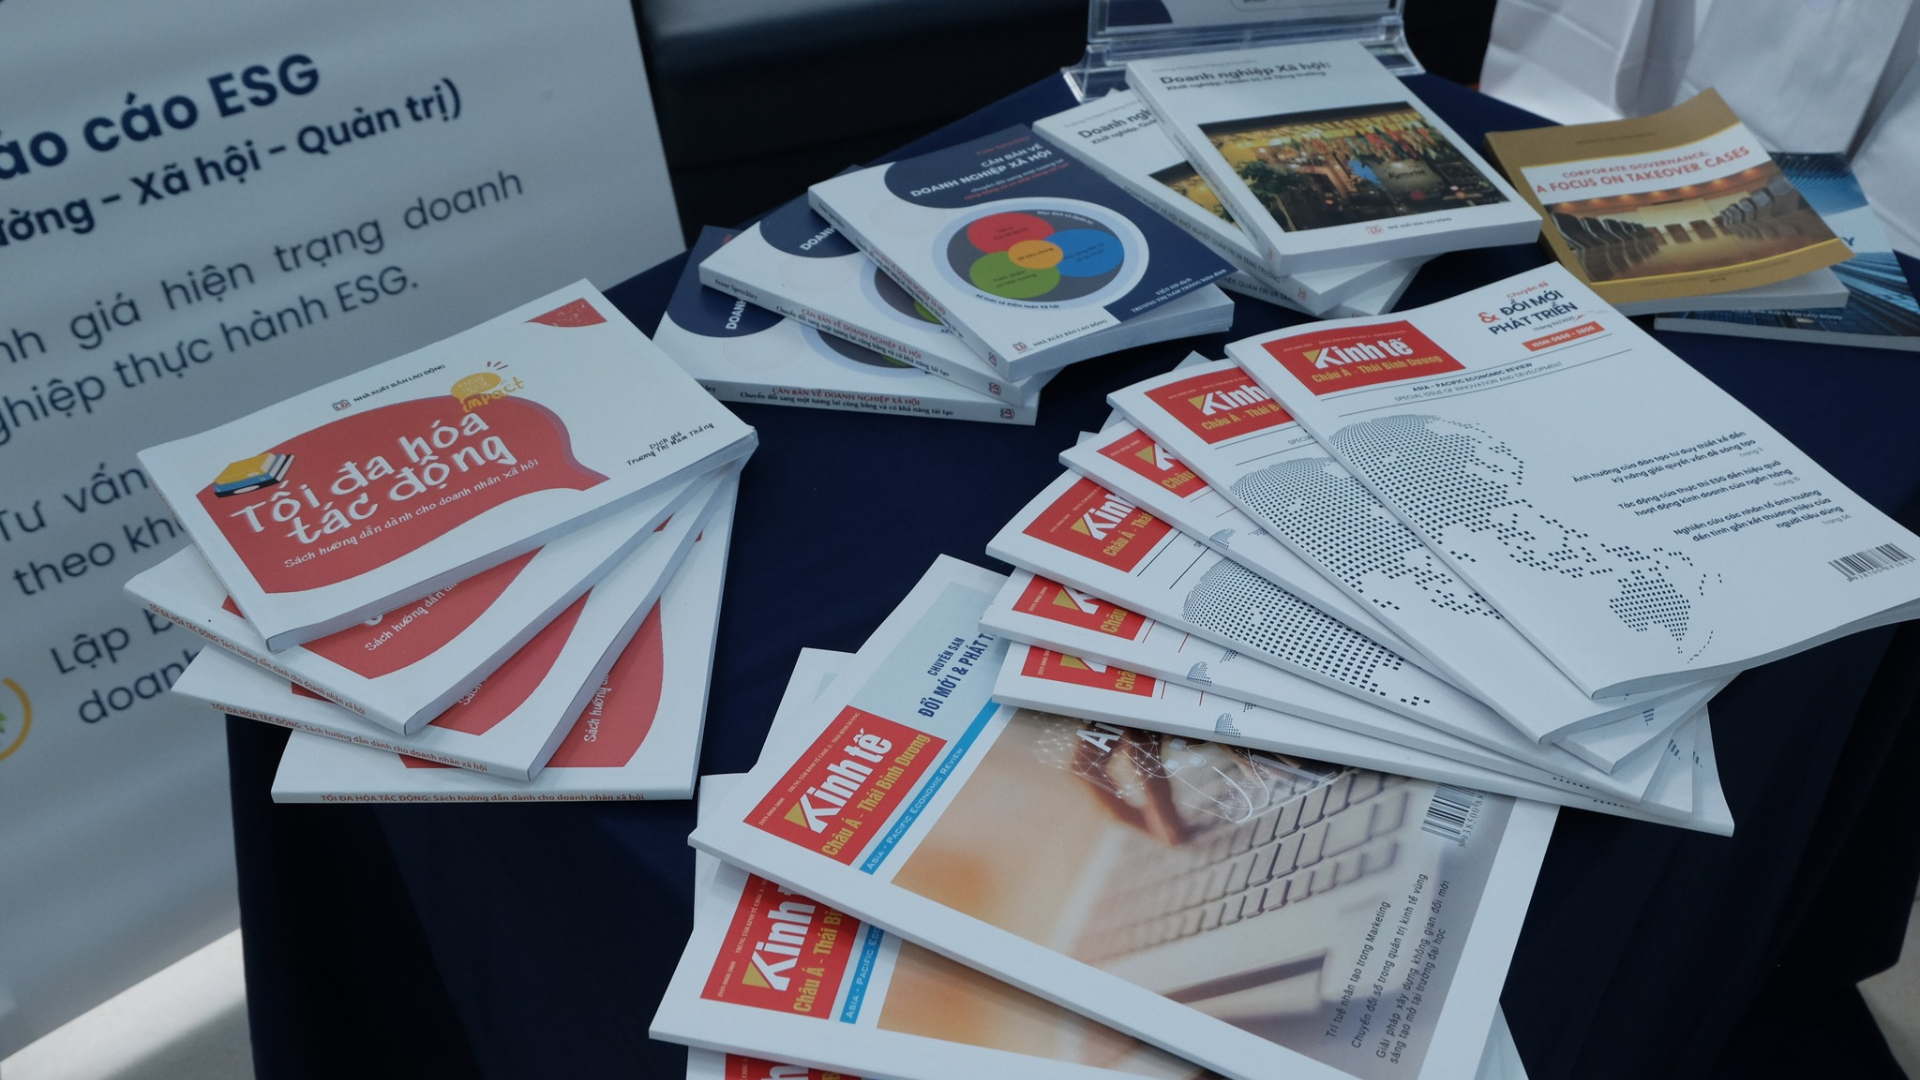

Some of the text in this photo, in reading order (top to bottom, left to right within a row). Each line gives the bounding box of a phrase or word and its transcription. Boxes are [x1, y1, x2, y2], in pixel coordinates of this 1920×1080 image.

[1160, 72, 1215, 84] Doanh
[1218, 67, 1274, 80] nghiệp
[83, 53, 321, 152] cáo ESG
[130, 77, 463, 206] Xã hội Quản trị)
[1536, 145, 1751, 194] A FOCUS ON TAKEOVER CASES
[1562, 150, 1709, 179] CORPORATE GOVERNANCE:
[909, 180, 960, 198] DOANH
[70, 170, 524, 350] giá hiện trạng doanh
[1478, 289, 1565, 324] & ĐỔI MỚI
[1488, 302, 1579, 335] PHÁT TRIỂN
[113, 265, 419, 388] thực hành ESG.
[1303, 343, 1386, 369] Kinh
[1379, 337, 1413, 358] tế
[1312, 370, 1342, 383] Châu
[1342, 366, 1351, 378] Á
[1358, 362, 1383, 374] Thái
[1202, 405, 1269, 430] Châu Á Thái
[229, 412, 490, 534] Tối đa hóa
[62, 462, 149, 514] vấn
[286, 435, 518, 545] tác động
[284, 458, 539, 568] Sách hướng dẫn dành cho doanh nhân xã hội
[1673, 523, 1707, 536] Nghiên
[12, 541, 115, 596] theo
[364, 631, 393, 652] Sách
[391, 607, 429, 633] hướng
[50, 626, 131, 675] Lập
[927, 637, 965, 677] CHUYÊN SAN
[958, 640, 989, 667] PHÁT
[951, 667, 969, 676] &
[933, 674, 962, 698] MỚI
[918, 697, 944, 718] ĐỔI
[304, 724, 323, 734] Sách
[324, 729, 352, 741] hướng
[371, 739, 392, 750] dành
[393, 744, 409, 753] cho
[410, 749, 437, 760] doanh
[473, 761, 488, 772] hội
[784, 727, 893, 834] Kinh tế
[821, 733, 932, 856] Châu Á Thái Bình Dương
[867, 747, 964, 870] ASIA PACIFIC ECONOMIC REVIEW
[1414, 873, 1429, 895] vùng
[1439, 879, 1451, 899] mới
[1401, 905, 1414, 924] kinh
[1409, 895, 1418, 906] tế
[1397, 921, 1408, 938] trị
[1424, 911, 1437, 936] gian
[1435, 928, 1446, 947] học
[742, 900, 816, 991] Kinh
[1388, 936, 1402, 961] quản
[1411, 938, 1431, 966] không
[1428, 944, 1440, 961] đại
[793, 927, 838, 1013] Châu Á Thái
[1326, 901, 1392, 1039] Trí tuệ nhân tạo trong Marketing
[1377, 959, 1395, 984] trong
[1402, 966, 1420, 991] dựng
[1418, 960, 1436, 990] trường
[1400, 991, 1410, 1011] xây
[1414, 990, 1423, 1007] tại
[1352, 1015, 1372, 1049] Chuyển
[1386, 1012, 1402, 1037] pháp
[1400, 1018, 1411, 1040] tạo
[1376, 1037, 1391, 1059] Giải
[1390, 1038, 1407, 1065] sáng
